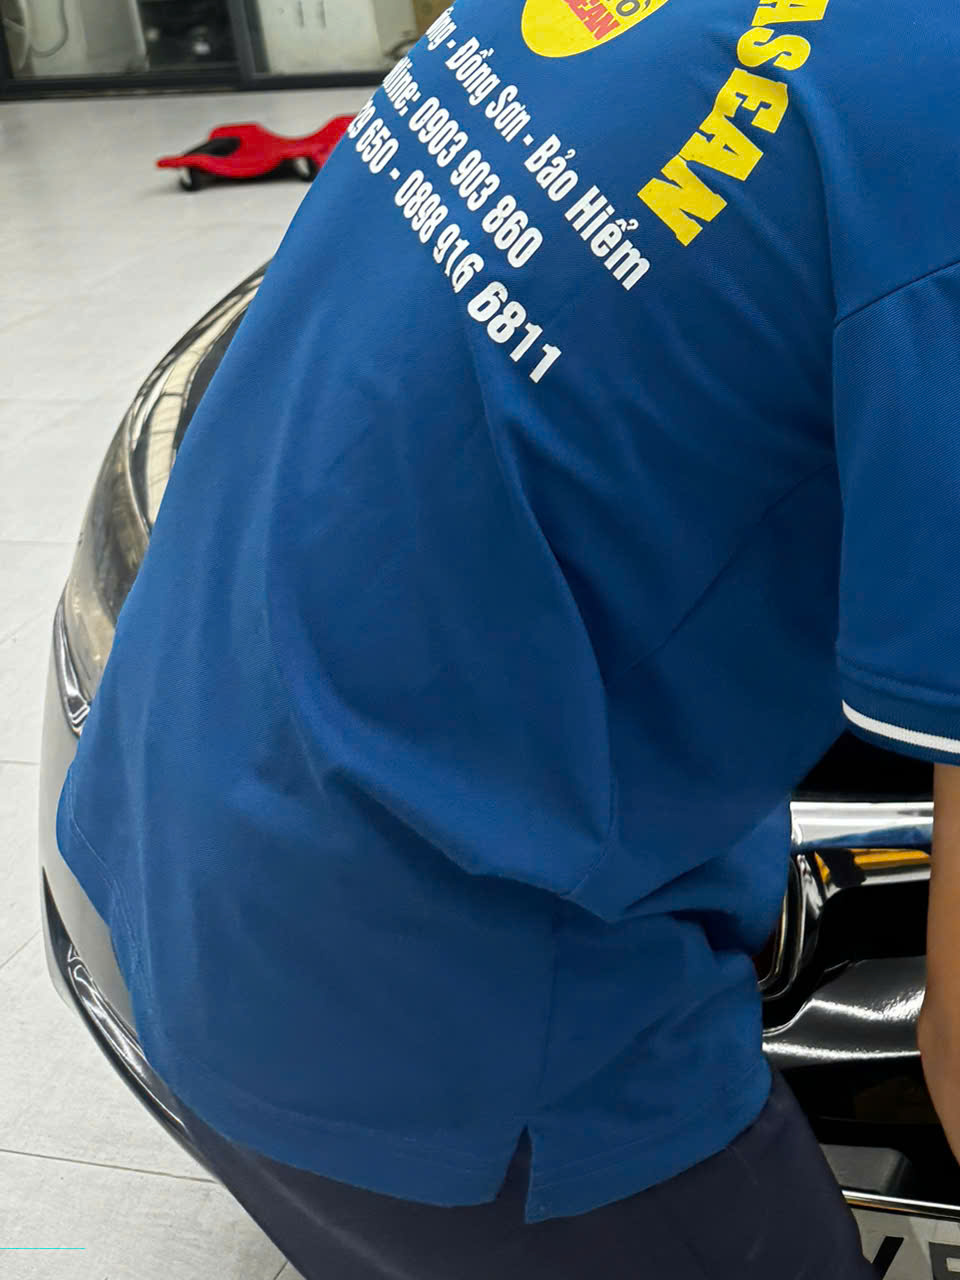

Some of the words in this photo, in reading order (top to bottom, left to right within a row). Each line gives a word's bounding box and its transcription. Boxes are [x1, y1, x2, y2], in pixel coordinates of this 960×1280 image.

[355, 118, 400, 174] 650
[394, 169, 449, 244] 0898
[433, 223, 485, 293] 916
[467, 281, 562, 383] 6811
[408, 96, 469, 168] 0903
[450, 149, 500, 211] 903
[481, 194, 543, 268] 860
[444, 36, 501, 106] Đồng
[484, 84, 532, 143] Sơn
[523, 133, 579, 202] Bảo
[564, 184, 651, 291] Hiểm
